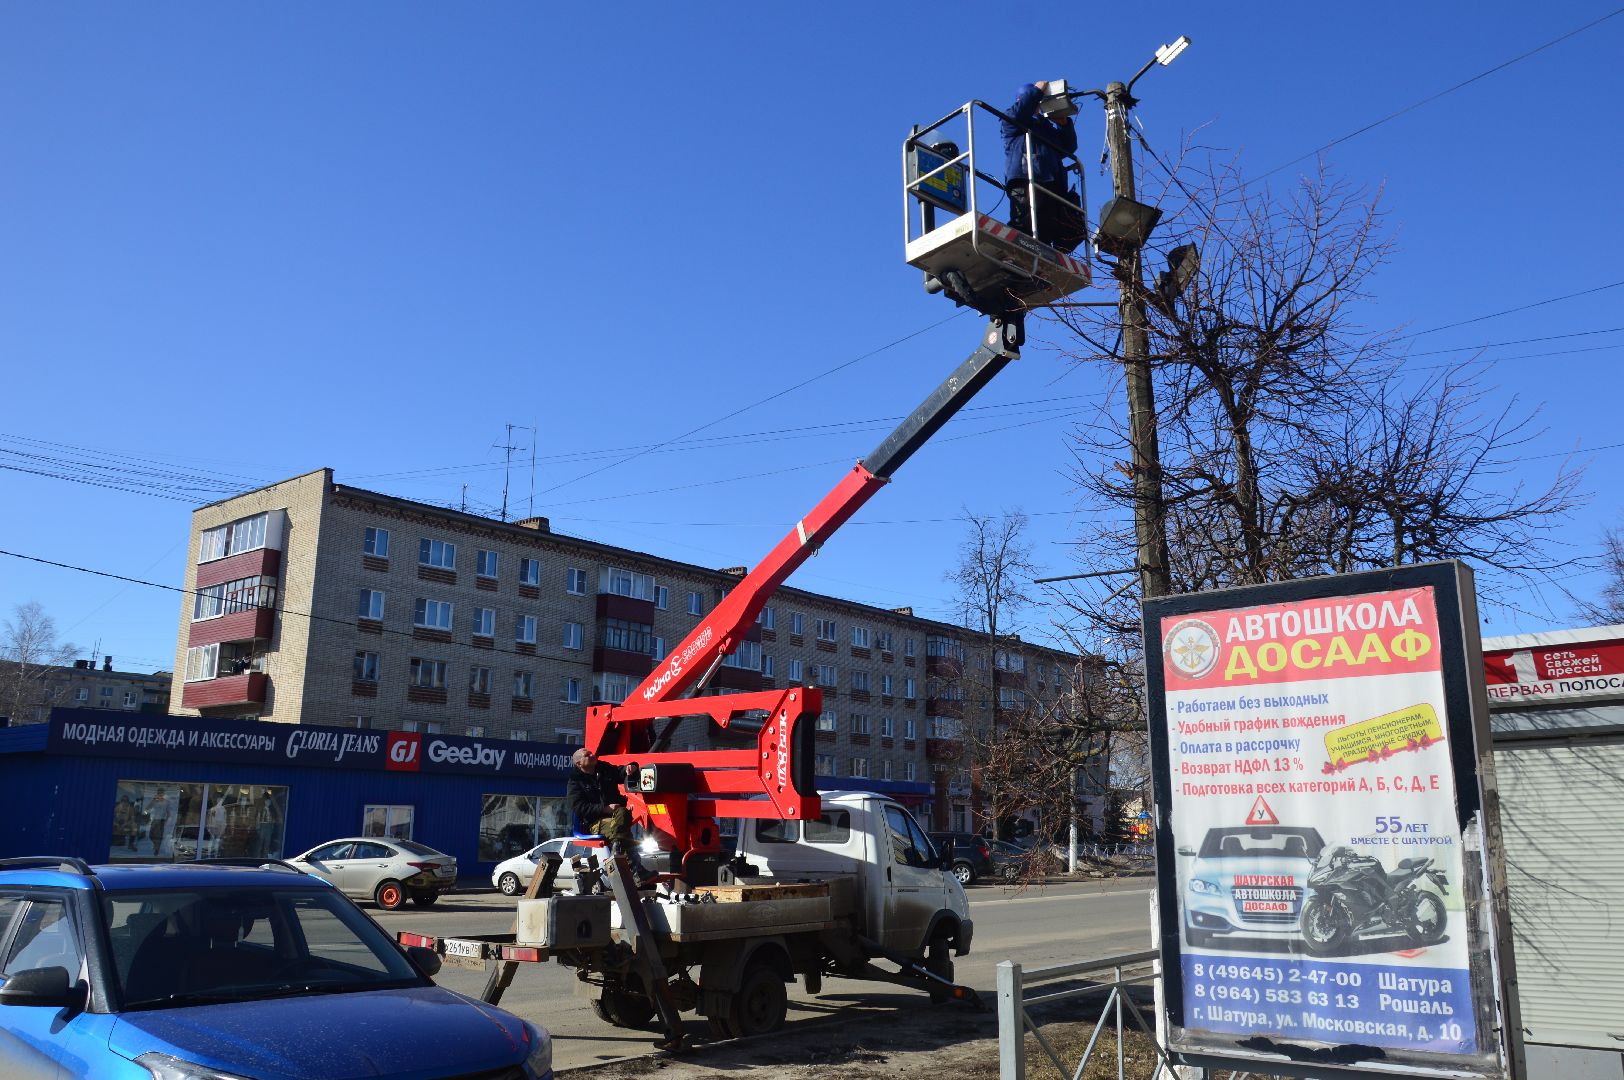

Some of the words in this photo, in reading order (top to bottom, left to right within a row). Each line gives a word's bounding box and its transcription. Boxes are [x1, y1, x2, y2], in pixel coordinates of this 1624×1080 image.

[1225, 598, 1423, 644] АВТОШКОЛА
[1224, 629, 1432, 680] ДОСААФ
[1543, 651, 1576, 661] сеть
[1545, 654, 1600, 669] свежей
[1504, 650, 1539, 683] 1
[1547, 664, 1602, 677] прессы
[1487, 683, 1554, 698] ПЕРВАЯ
[1177, 698, 1236, 714] Работаем
[1239, 696, 1261, 709] без
[1264, 692, 1329, 709] выходных
[1178, 719, 1230, 735] Удобный
[1233, 718, 1279, 734] график
[1282, 714, 1346, 730] вождения
[62, 722, 125, 745] МОДНАЯ
[128, 726, 185, 748] ОДЕЖДА
[188, 730, 198, 747] И
[200, 731, 275, 751] АКСЕССУАРЫ
[1180, 739, 1221, 755] Оплата
[1225, 741, 1233, 751] в
[1236, 738, 1301, 755] рассрочку
[1337, 730, 1366, 744] ЛЬГОТЫ
[428, 739, 507, 771] GeeJay
[514, 752, 551, 769] МОДНАЯ
[552, 755, 575, 771] ОДЕЖ
[1181, 760, 1232, 776] Возврат
[1235, 758, 1270, 776] НДФЛ
[1274, 758, 1290, 772] 13
[1293, 758, 1304, 772] %
[1182, 781, 1252, 797] Подготовка
[1255, 782, 1286, 794] всех
[1289, 777, 1356, 796] категорий
[1430, 774, 1440, 790] Е
[1375, 816, 1403, 834] 55
[1404, 823, 1428, 834] ЛЕТ
[1351, 837, 1388, 845] ВМЕСТЕ
[1391, 837, 1398, 845] С
[1401, 835, 1452, 845] ШАТУРОЙ
[1233, 874, 1294, 887] ШАТУРСКАЯ
[1234, 888, 1297, 901] АВТОШКОЛА
[1243, 902, 1289, 912] ДОСААФ
[1194, 964, 1204, 977] 8
[1208, 964, 1283, 982] (49645)
[1289, 969, 1362, 987] 2-47-00
[1378, 972, 1452, 994] Шатура
[1194, 984, 1205, 997] 8
[1209, 985, 1260, 1004] (964)
[1266, 989, 1302, 1003] 583
[1307, 992, 1329, 1006] 63
[1335, 994, 1360, 1009] 13
[1380, 993, 1453, 1015] Рошаль
[1193, 1008, 1205, 1020] г.
[1207, 1006, 1271, 1027] Шатура,
[1276, 1012, 1298, 1030] ул.
[1303, 1012, 1412, 1039] Московская,
[1417, 1028, 1434, 1041] д.
[1439, 1022, 1462, 1041] 10
